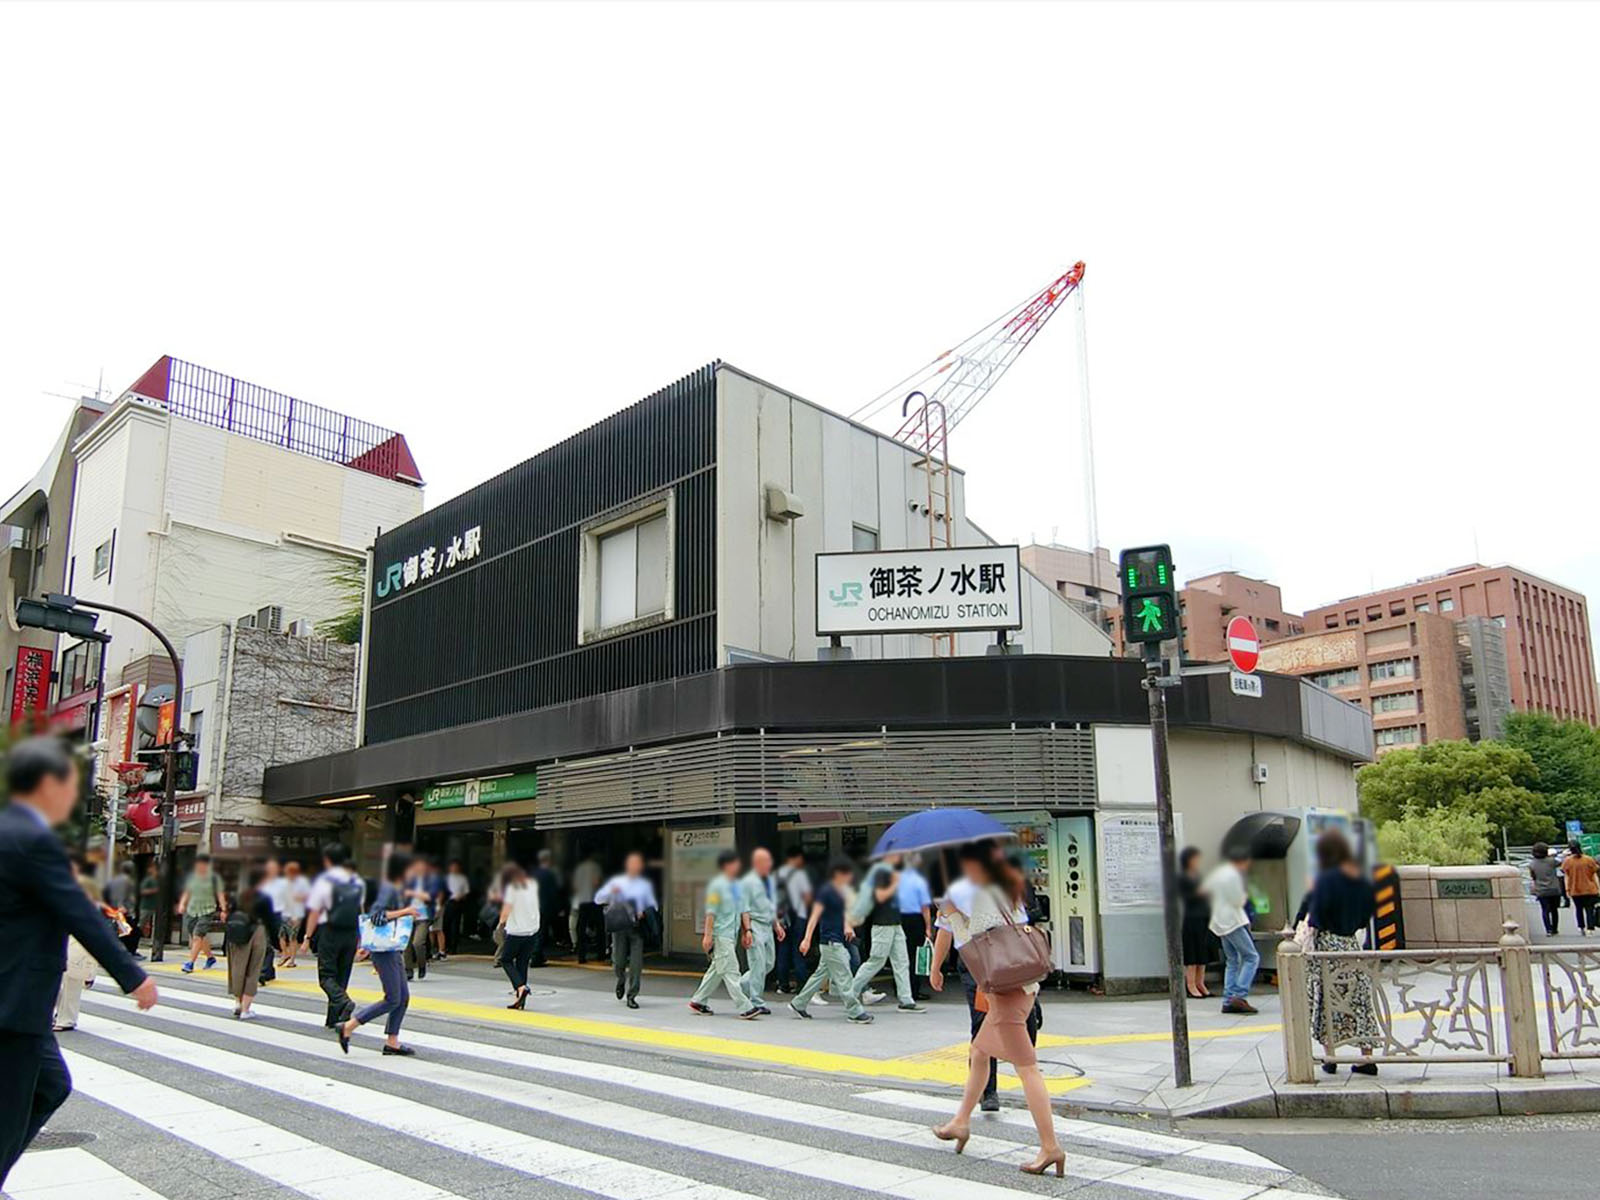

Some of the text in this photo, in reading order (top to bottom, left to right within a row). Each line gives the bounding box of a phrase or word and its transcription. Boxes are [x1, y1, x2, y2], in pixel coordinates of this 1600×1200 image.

[378, 525, 481, 598] JR 御茶ノ水駅
[829, 562, 1006, 601] JR 御茶ノ水駅
[868, 603, 1008, 621] OCHANOMIZU STATION
[428, 788, 440, 802] JR
